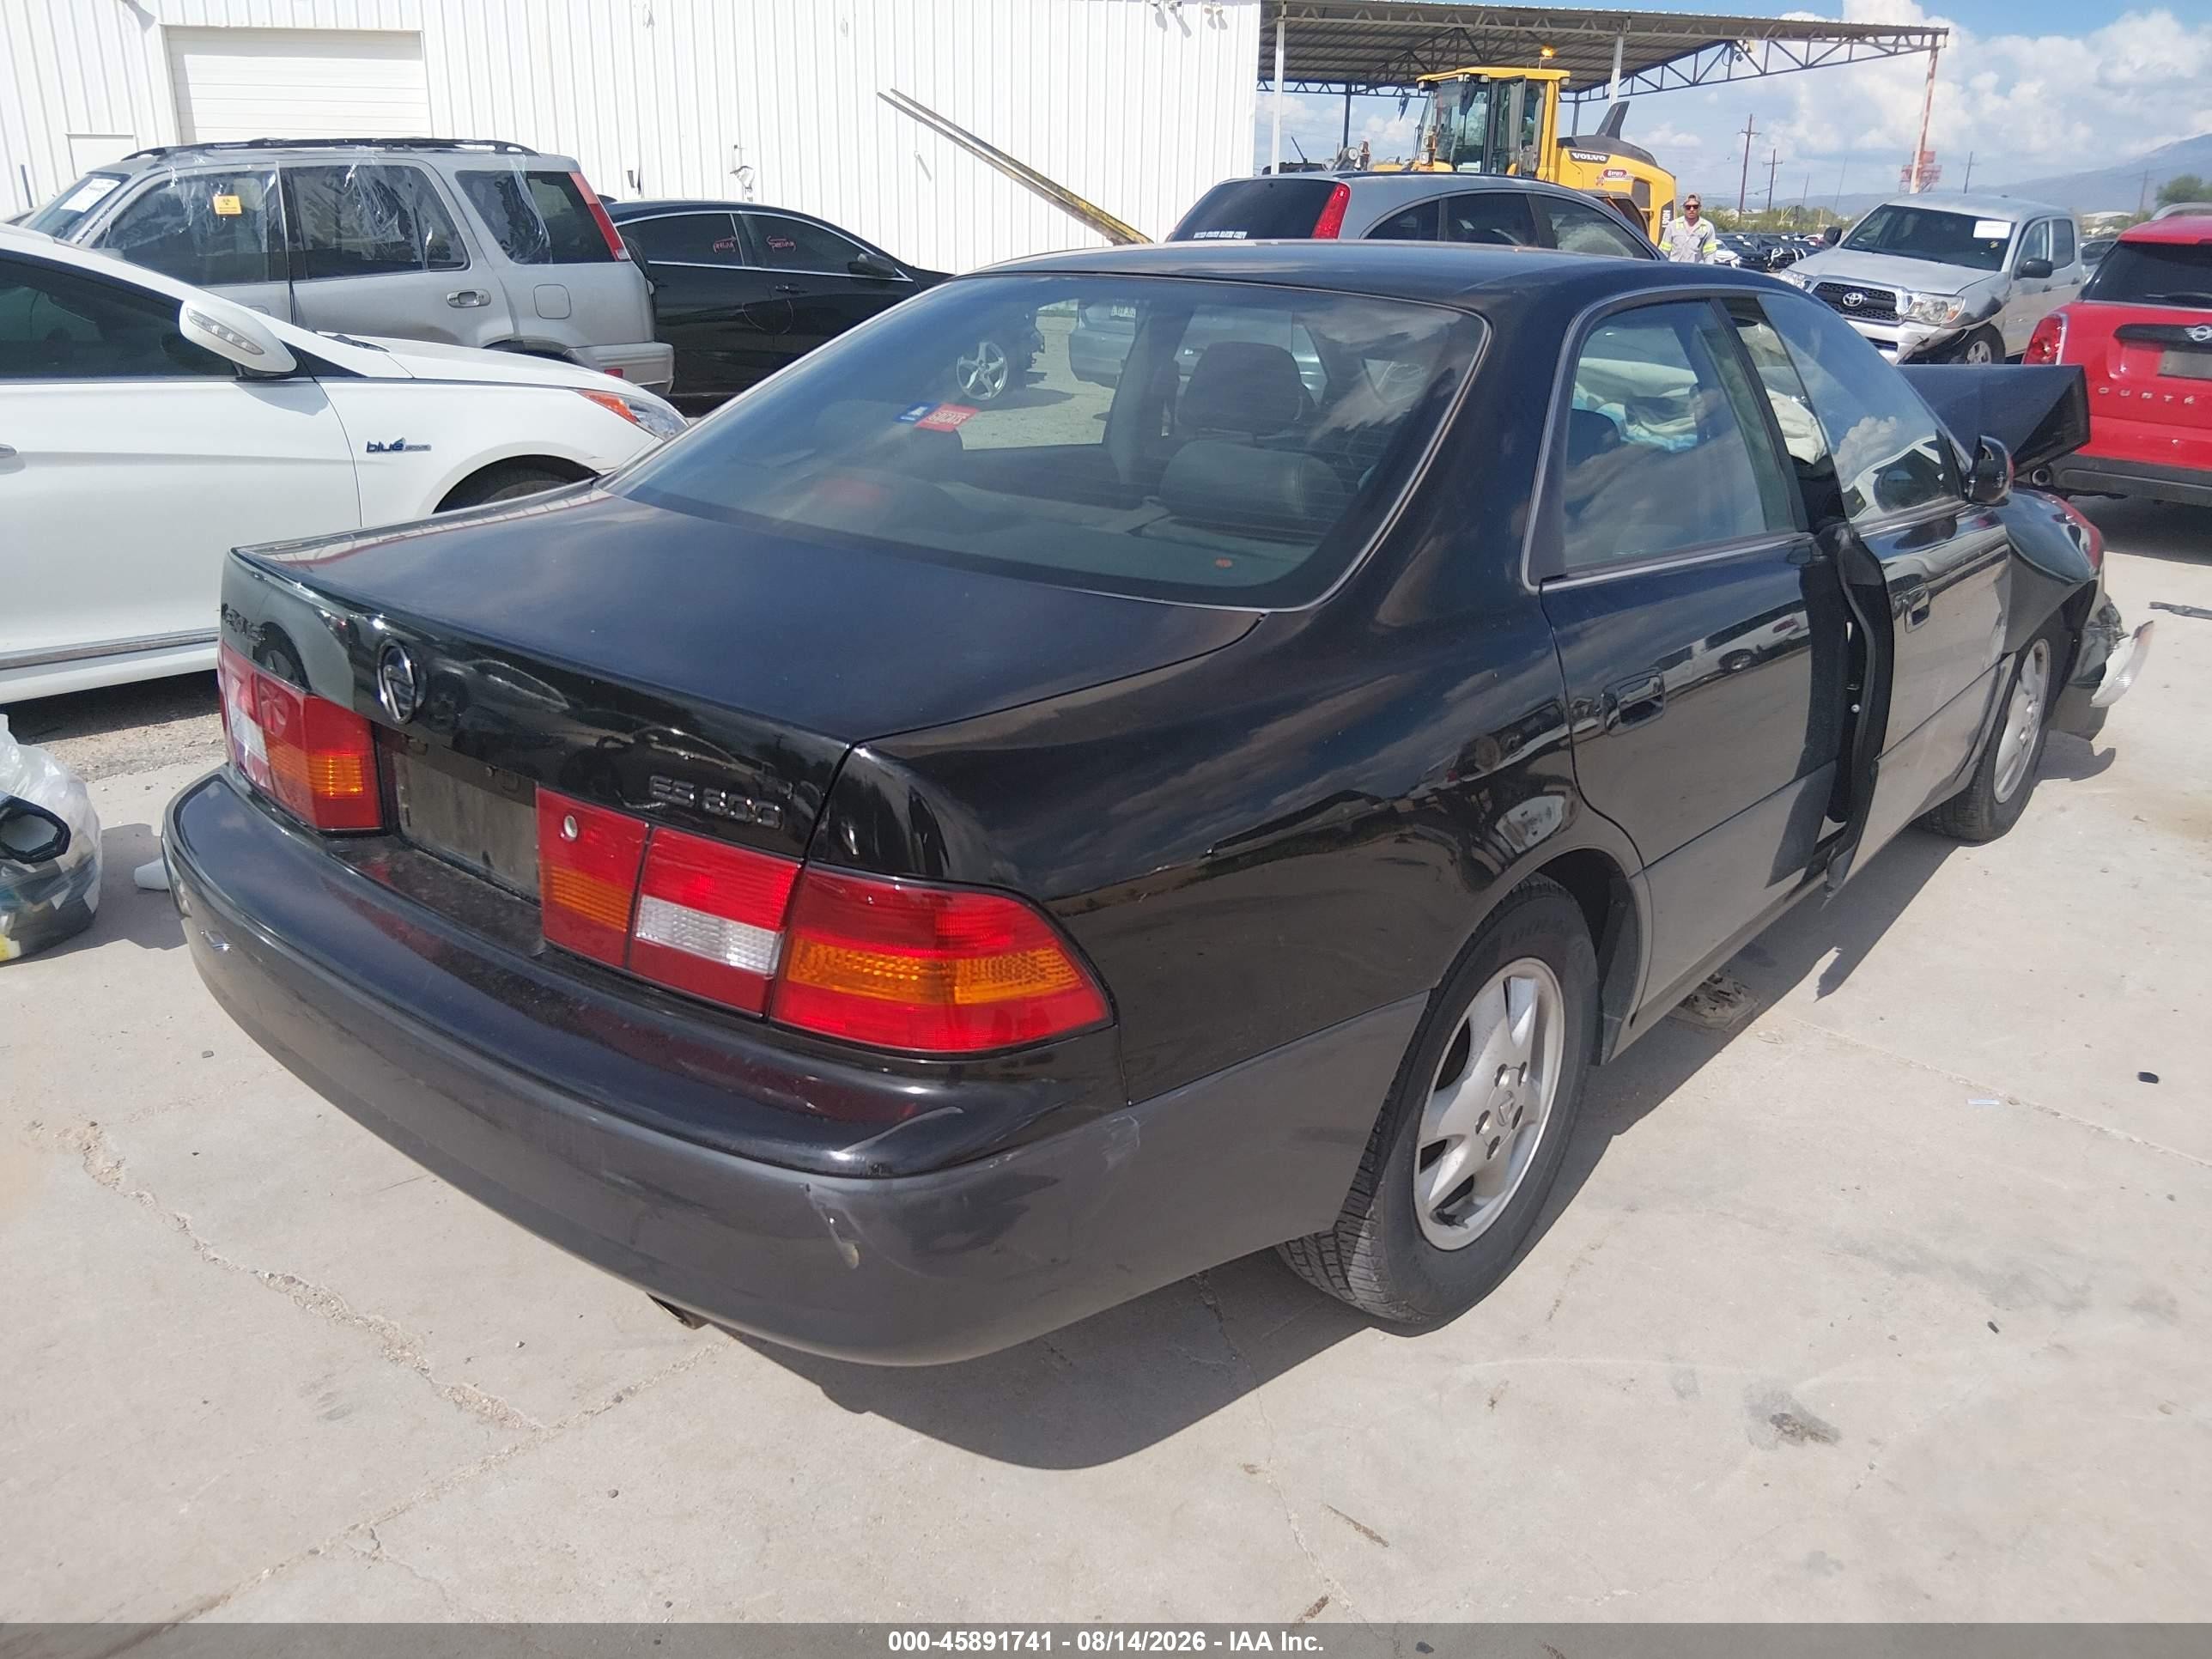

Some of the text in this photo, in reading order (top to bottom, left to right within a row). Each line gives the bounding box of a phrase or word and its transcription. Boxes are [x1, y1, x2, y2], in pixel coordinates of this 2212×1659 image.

[1571, 152, 1607, 161] VOLVO
[366, 438, 405, 453] blue
[648, 775, 695, 808] ES
